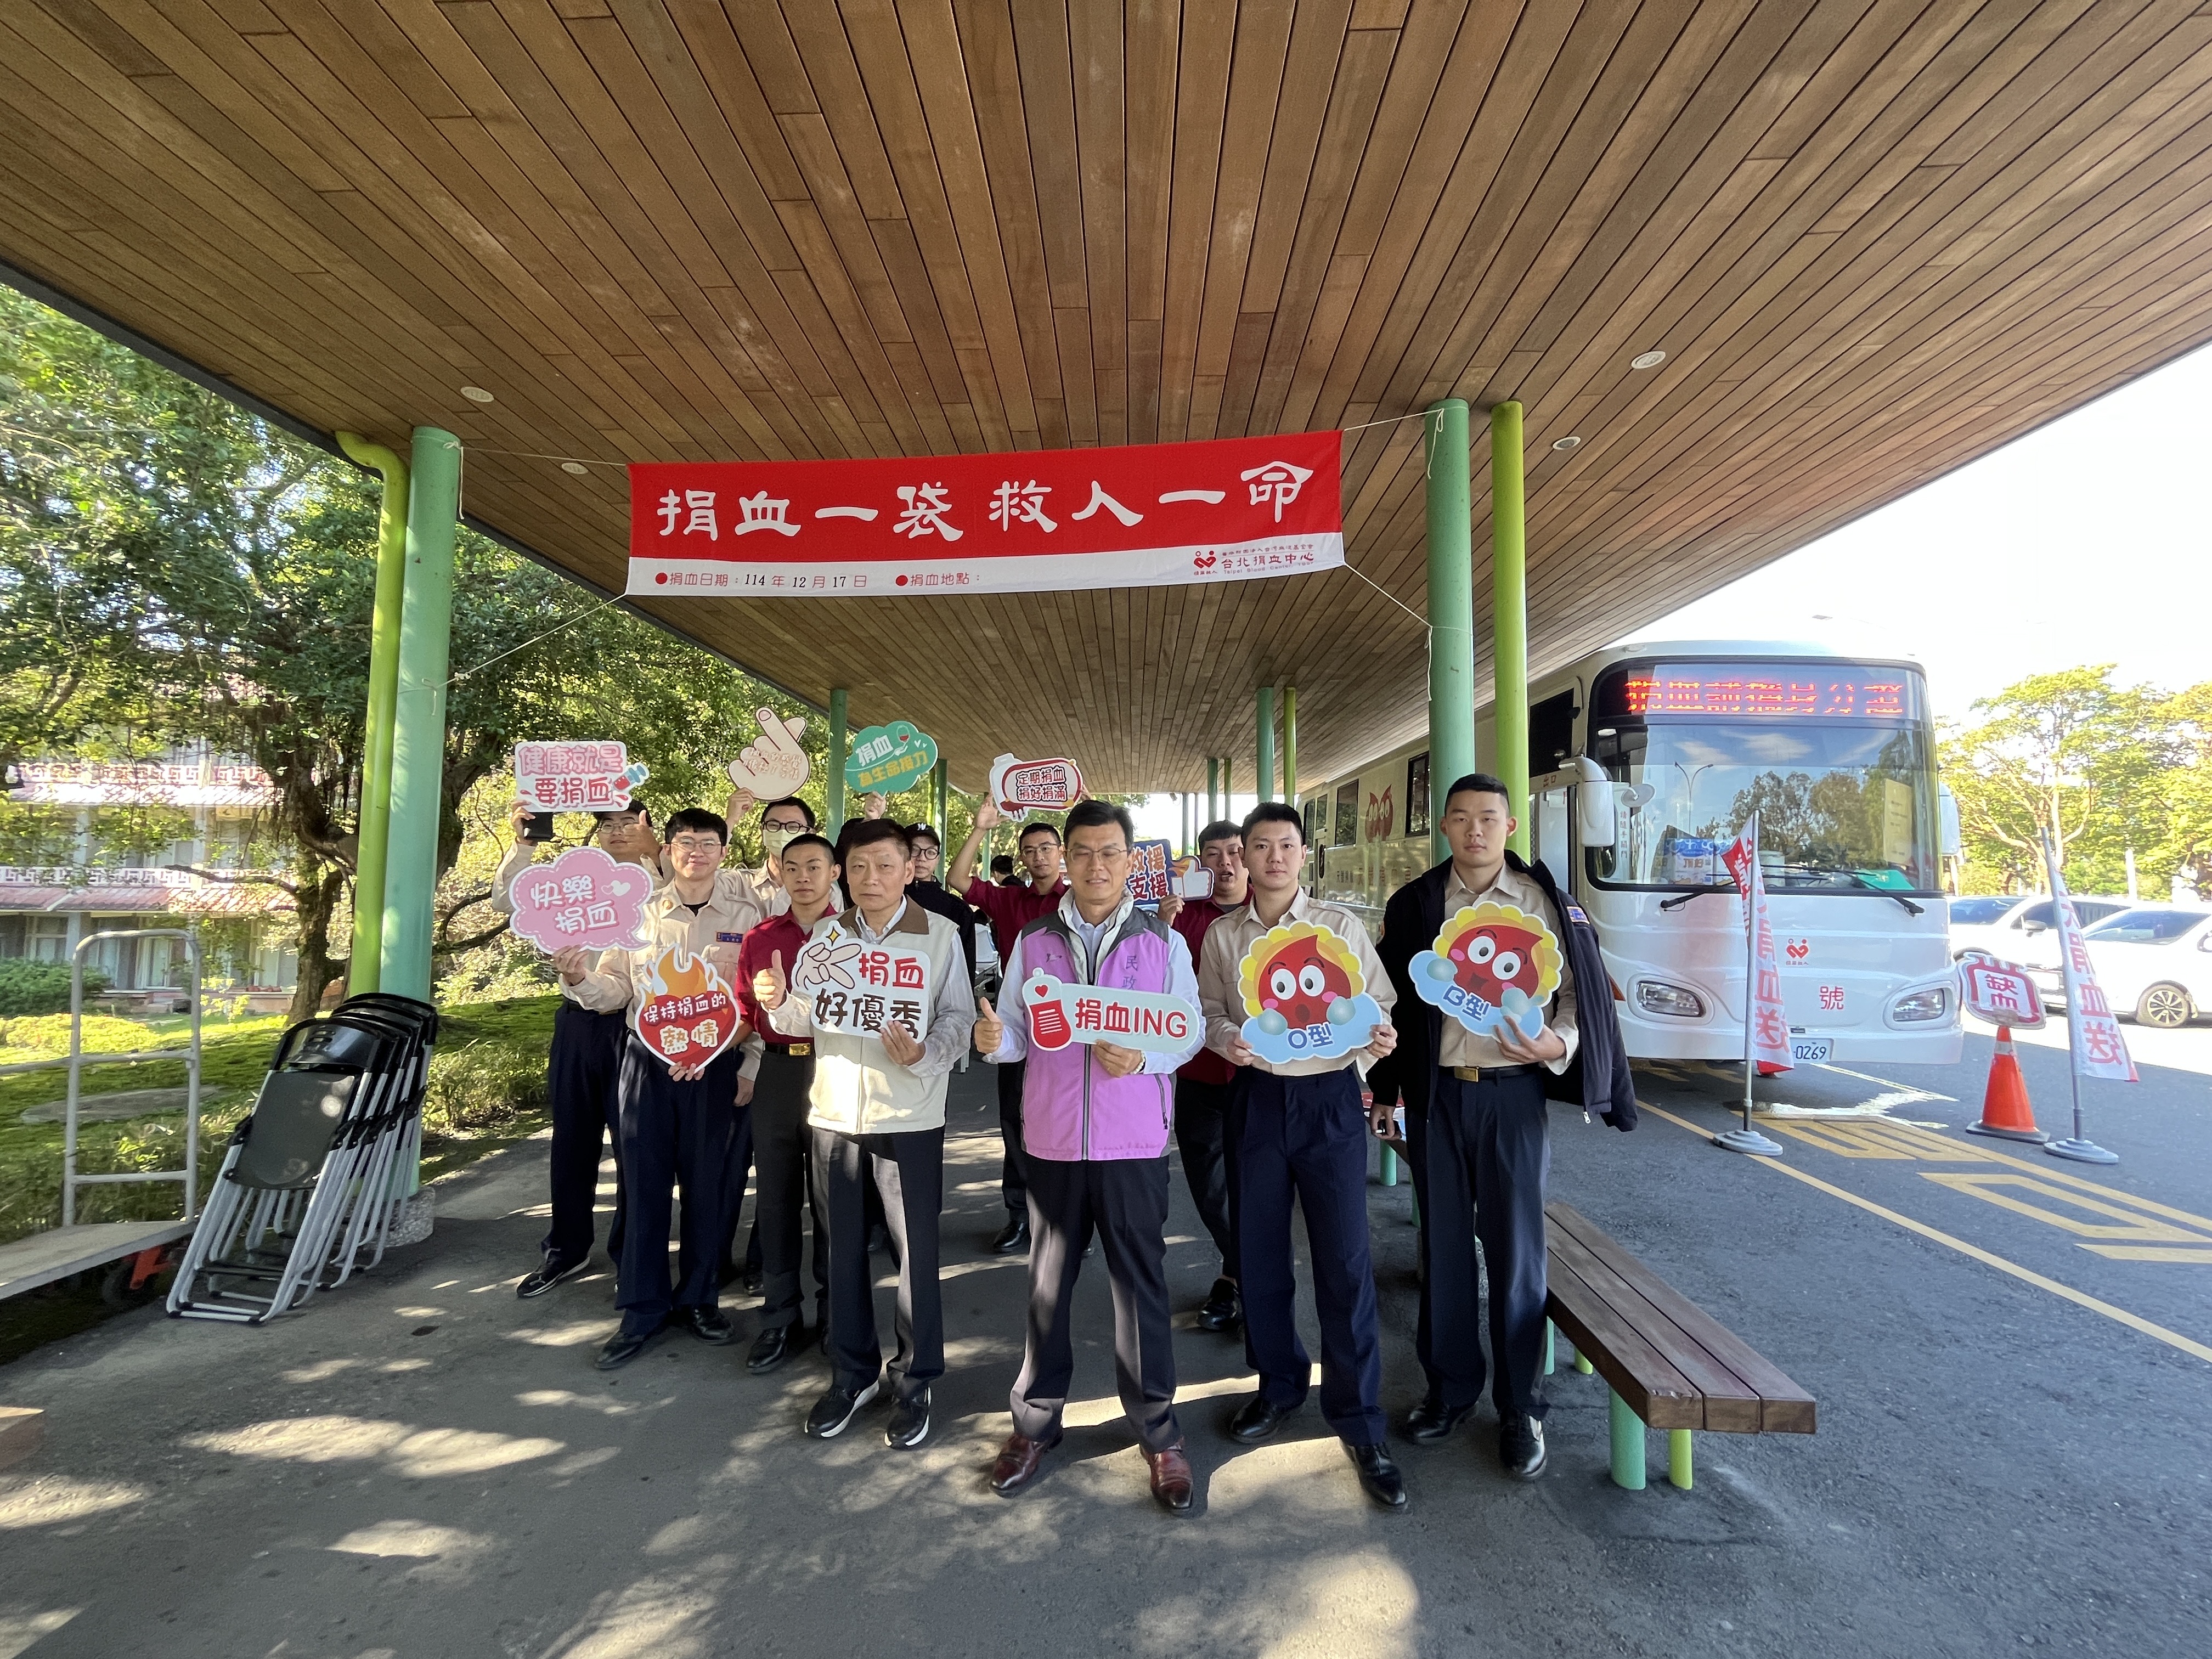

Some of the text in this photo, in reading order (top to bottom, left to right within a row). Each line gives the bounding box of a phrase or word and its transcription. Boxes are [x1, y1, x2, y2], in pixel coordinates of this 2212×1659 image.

[657, 460, 1314, 541] 捐血一袋 救人一命
[1221, 552, 1314, 569] 台北捐血中心
[519, 745, 623, 775] 健康就是
[855, 735, 894, 767] 捐血
[857, 750, 928, 788] 為生命接力
[1015, 765, 1066, 786] 定期捐血
[534, 777, 611, 804] 要捐血
[1017, 783, 1067, 802] 捐好捐滿
[531, 875, 596, 909] 快樂
[1128, 872, 1169, 900] 支援
[555, 901, 618, 934] 捐血
[859, 951, 924, 989] 捐血
[643, 992, 727, 1024] 保持捐血的
[815, 988, 922, 1039] 好優秀
[1442, 985, 1491, 1023] B型
[1819, 986, 1844, 1010] 號
[1074, 997, 1187, 1039] 捐血ING
[660, 1020, 719, 1054] 熱情
[1288, 1021, 1334, 1049] O型
